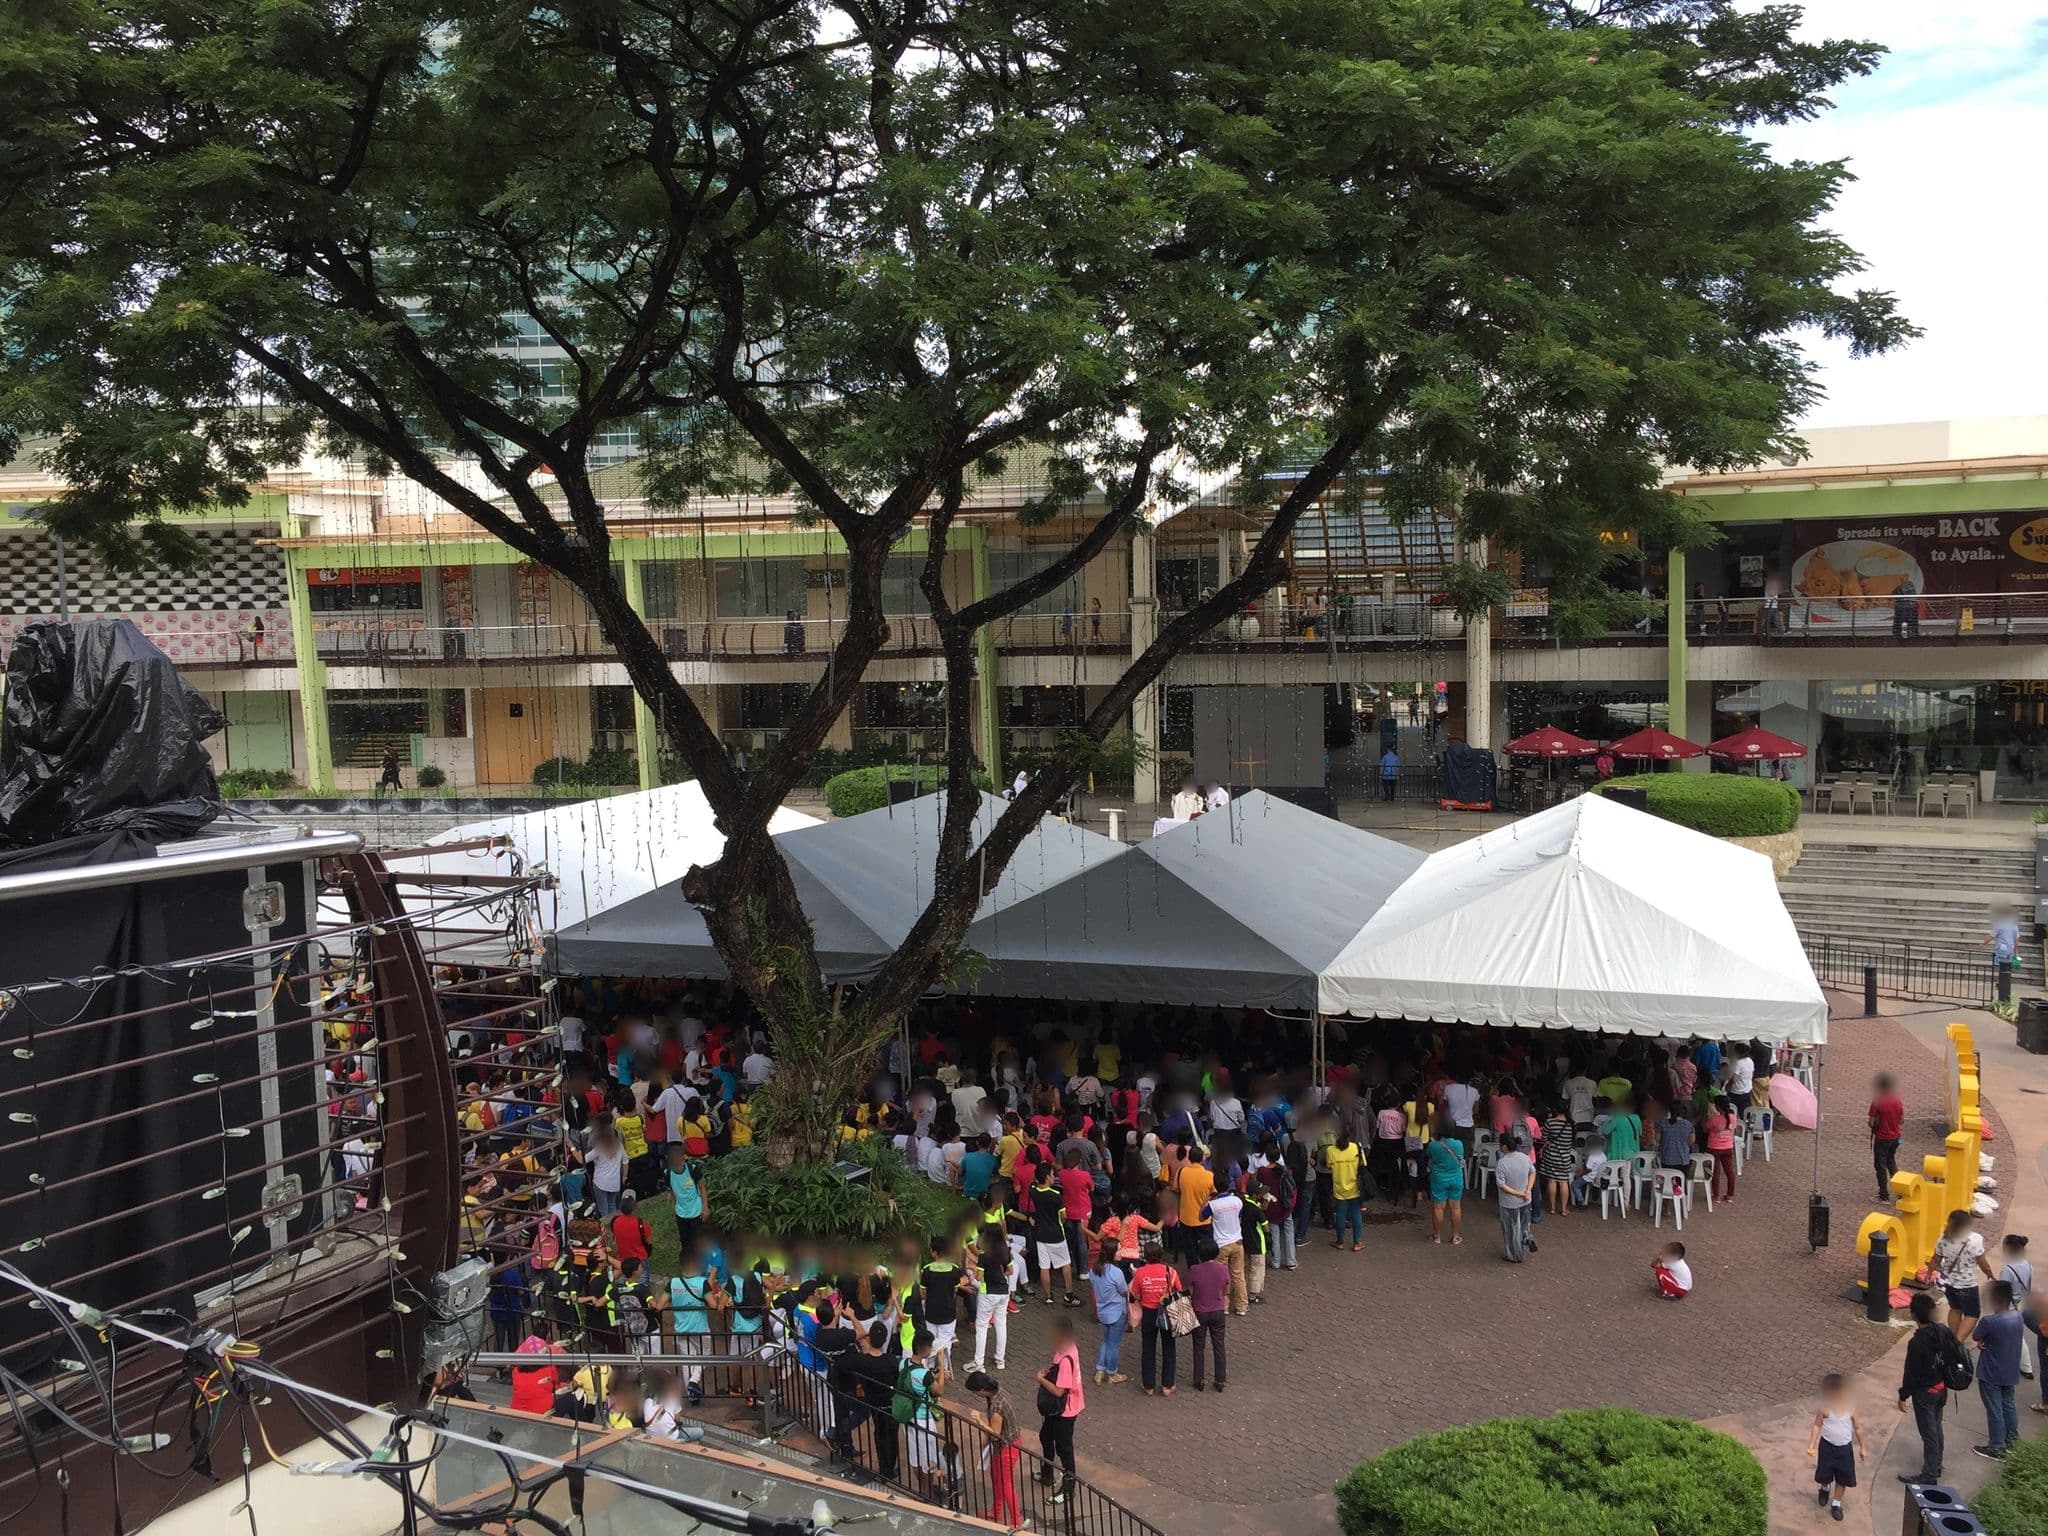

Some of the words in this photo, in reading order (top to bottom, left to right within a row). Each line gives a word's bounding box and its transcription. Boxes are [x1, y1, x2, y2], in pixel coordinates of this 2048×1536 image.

[1837, 528, 1882, 541] Spreads
[1884, 526, 1899, 537] its
[1901, 525, 1936, 539] wings
[1938, 517, 2000, 538] BACK
[1931, 549, 1946, 562] to
